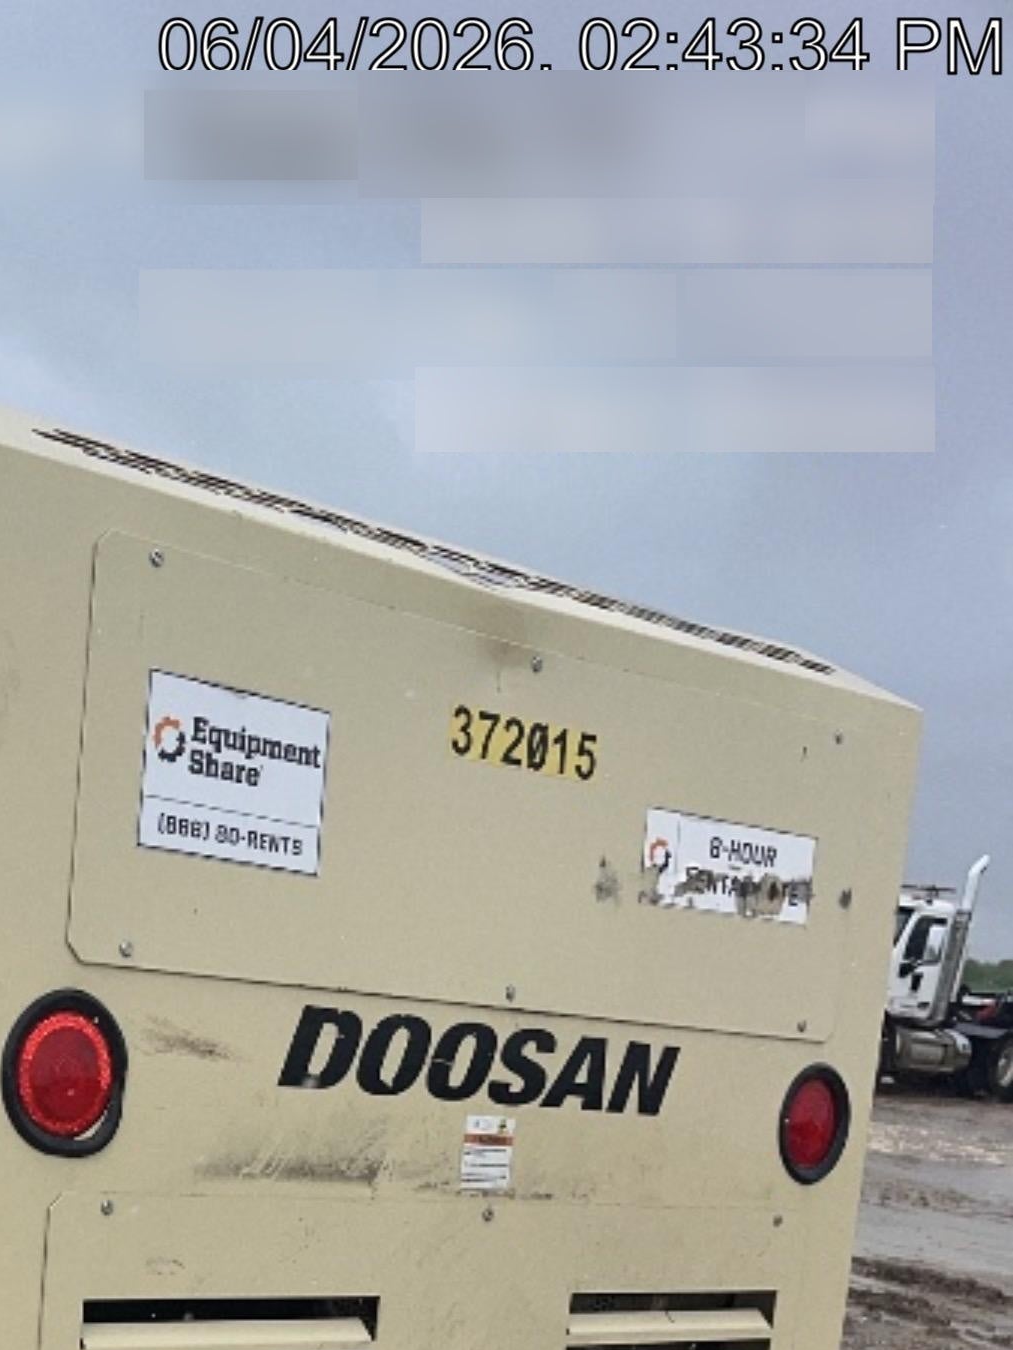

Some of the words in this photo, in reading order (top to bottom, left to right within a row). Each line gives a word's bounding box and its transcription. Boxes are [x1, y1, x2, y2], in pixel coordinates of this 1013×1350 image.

[188, 749, 262, 787] Share
[190, 716, 321, 769] Equipment
[451, 705, 598, 780] 372015
[157, 812, 210, 841] (888)
[215, 824, 304, 856] 80-RENTS
[278, 1004, 681, 1116] DOOSAN
